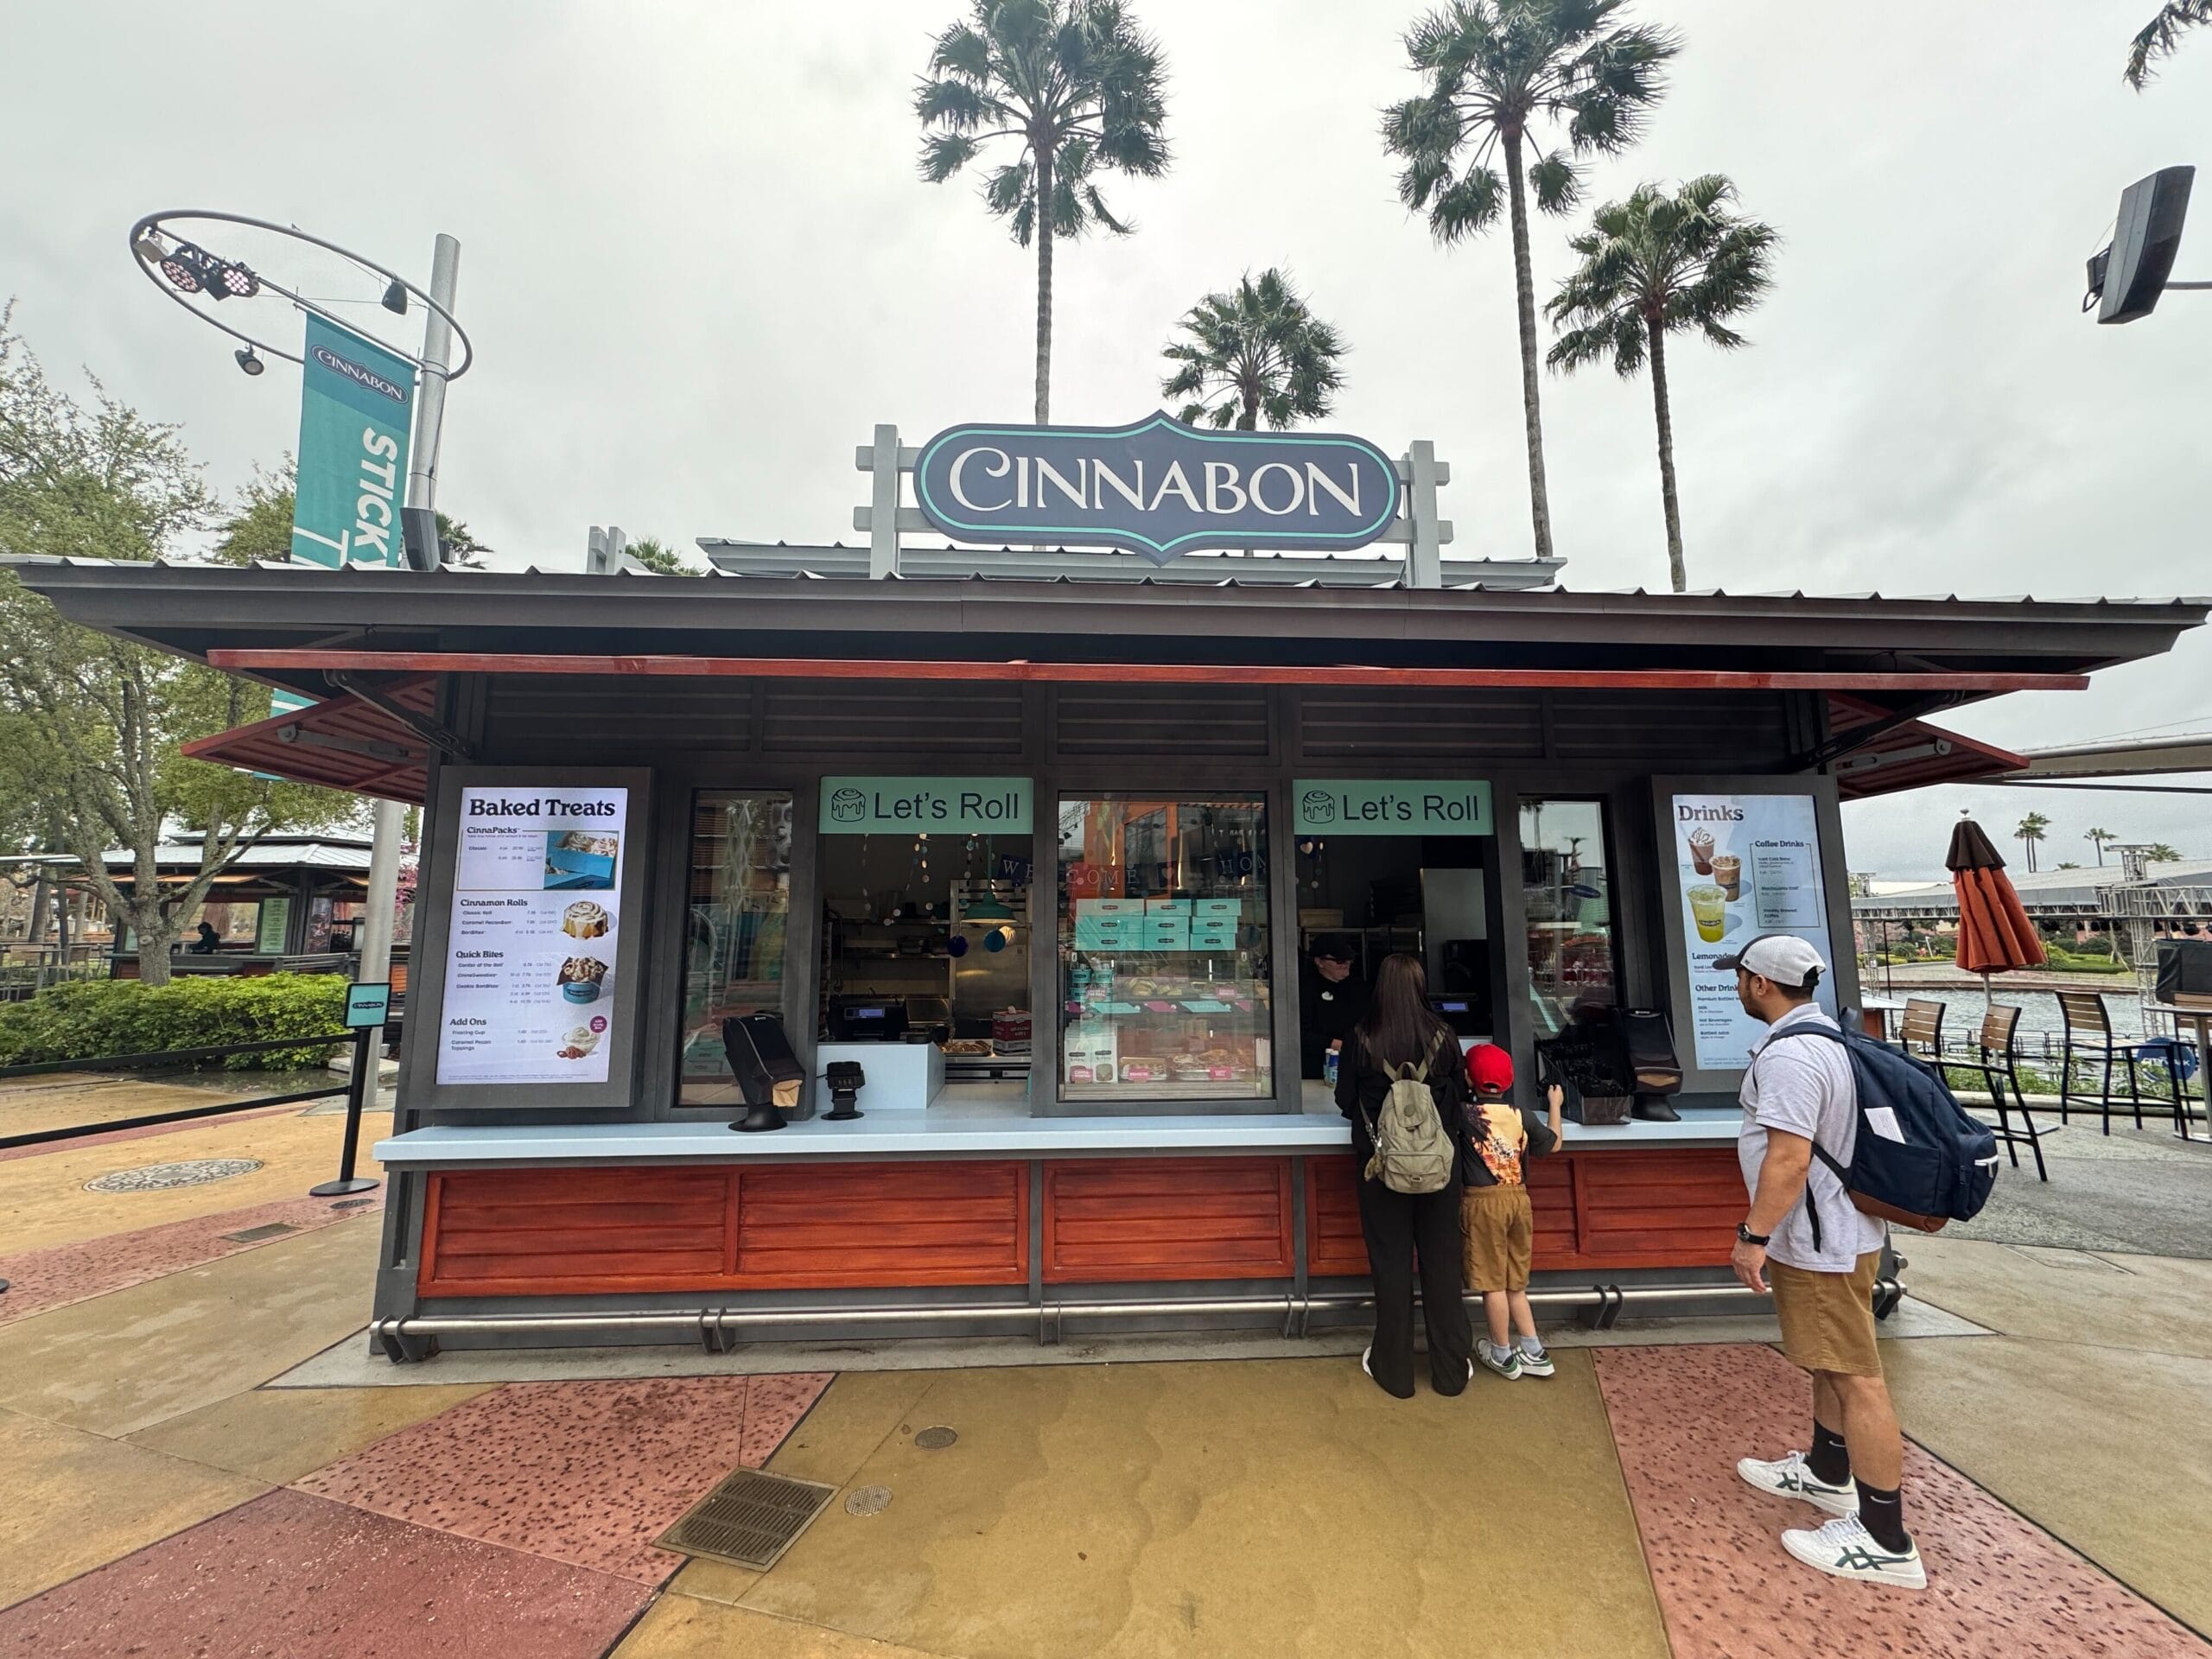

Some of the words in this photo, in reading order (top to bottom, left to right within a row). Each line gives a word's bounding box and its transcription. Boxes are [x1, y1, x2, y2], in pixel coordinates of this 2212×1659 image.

[318, 350, 403, 401] CINNABON
[950, 447, 1363, 518] CINNABON
[468, 798, 541, 817] Baked
[544, 798, 616, 817] Treats
[874, 792, 948, 819] Let's
[960, 792, 1019, 819] Roll
[1343, 794, 1413, 821] Let's
[1423, 795, 1478, 821] Roll
[1678, 805, 1745, 822] Drinks
[455, 950, 481, 959] Quick
